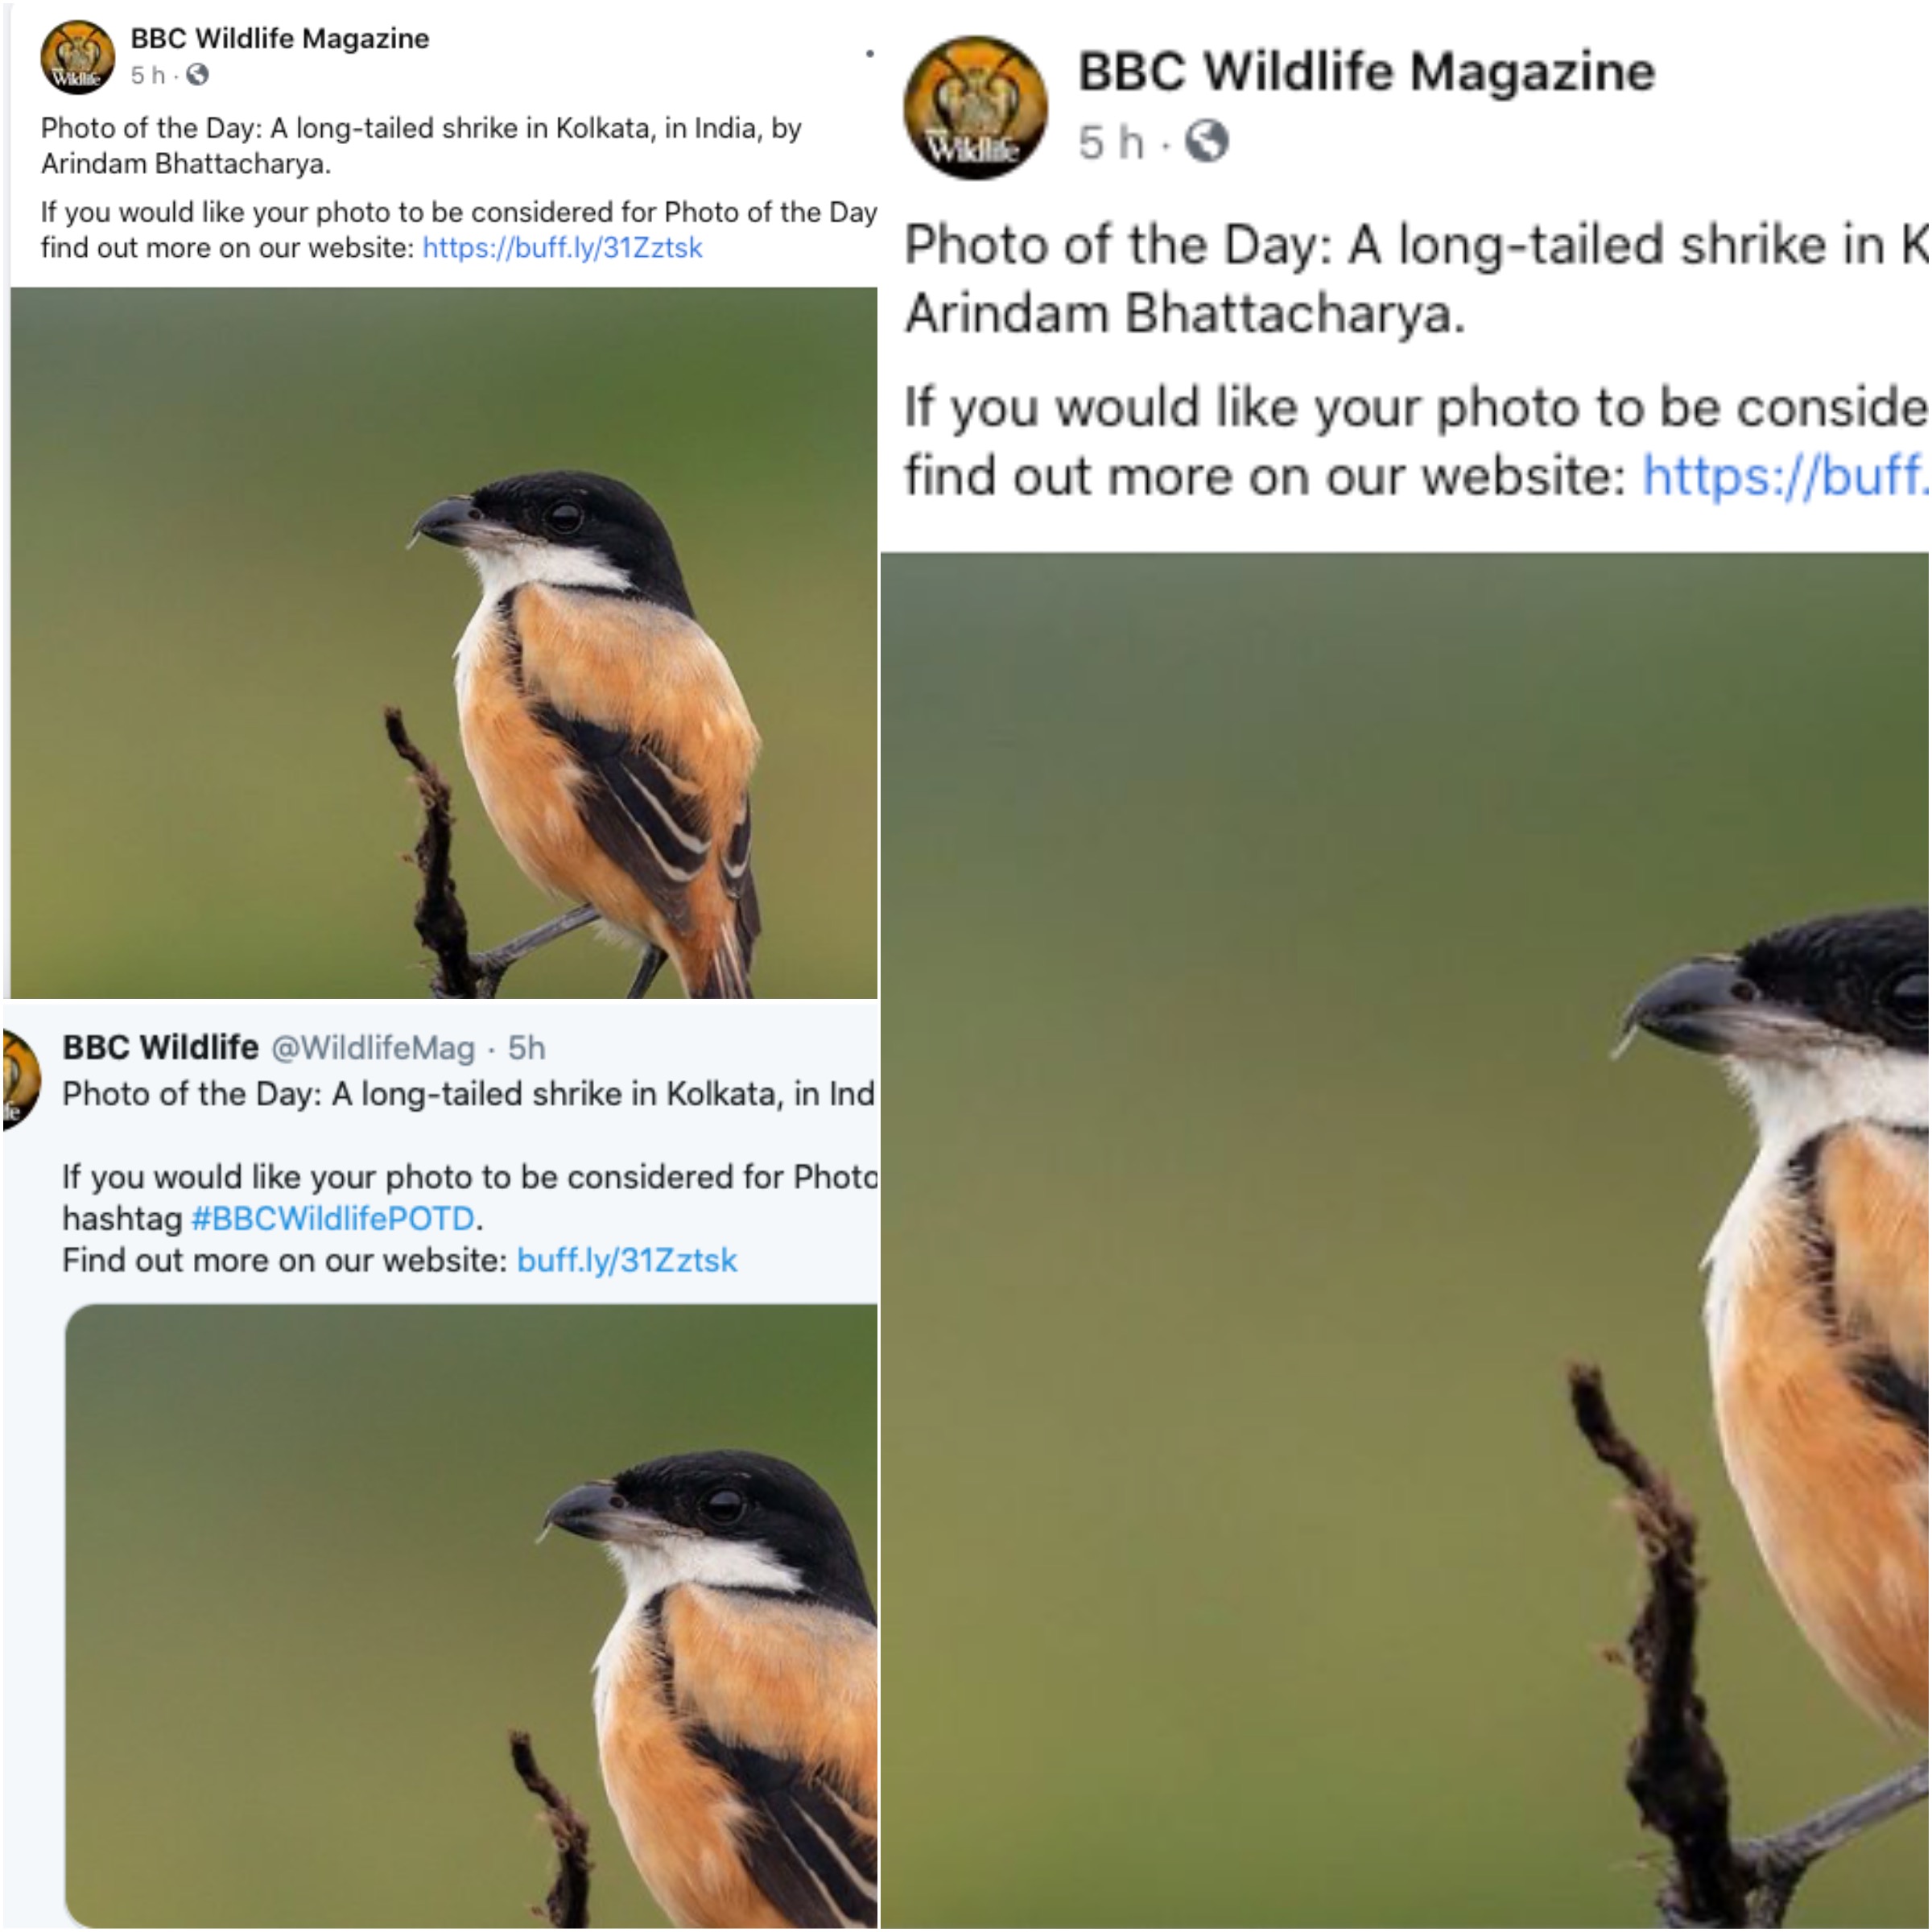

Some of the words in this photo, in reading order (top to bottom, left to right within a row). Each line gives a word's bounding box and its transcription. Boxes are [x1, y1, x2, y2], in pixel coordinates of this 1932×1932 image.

[131, 27, 188, 50] BBC
[195, 26, 295, 50] Wildlife
[303, 25, 431, 55] Magazine
[131, 65, 145, 85] 5
[152, 65, 165, 85] h
[1080, 48, 1187, 93] BBC
[1202, 47, 1396, 92] Wildlife
[1411, 47, 1657, 102] Magazine
[41, 115, 117, 139] Photo
[123, 114, 150, 139] of
[155, 115, 199, 139] the
[206, 116, 262, 145] Day:
[270, 116, 289, 139] A
[297, 115, 434, 145] long-tailed
[442, 115, 518, 139] shrike
[526, 114, 548, 139] in
[557, 115, 657, 144] Kolkata,
[665, 115, 687, 139] in
[696, 115, 763, 144] India,
[772, 115, 803, 145] by
[1080, 124, 1104, 160] 5
[1120, 124, 1144, 160] h
[40, 151, 147, 175] Arindam
[155, 151, 331, 180] Bhattacharya.
[41, 199, 58, 223] If
[64, 205, 111, 229] you
[118, 199, 194, 223] would
[202, 199, 246, 223] like
[252, 205, 310, 229] your
[316, 199, 391, 229] photo
[398, 200, 425, 223] to
[431, 199, 464, 223] be
[471, 199, 613, 223] considered
[621, 199, 658, 223] for
[665, 199, 740, 223] Photo
[747, 199, 774, 223] of
[779, 199, 822, 223] the
[830, 200, 877, 229] Day
[39, 234, 89, 258] find
[97, 237, 139, 259] out
[147, 242, 212, 259] more
[219, 242, 251, 258] on
[258, 242, 302, 258] our
[308, 234, 414, 259] website:
[423, 234, 704, 264] https://buff.ly/31Zztsk
[906, 220, 1050, 266] Photo
[1064, 220, 1114, 266] of
[1127, 220, 1208, 266] the
[1225, 221, 1331, 276] Day:
[1347, 222, 1383, 265] A
[1400, 219, 1664, 276] long-tailed
[1680, 220, 1827, 266] shrike
[1843, 219, 1885, 265] in
[903, 288, 1109, 334] Arindam
[1126, 288, 1465, 345] Bhattacharya.
[906, 382, 937, 427] If
[949, 395, 1038, 439] you
[1054, 382, 1199, 428] would
[1217, 382, 1299, 428] like
[1314, 395, 1424, 439] your
[1438, 382, 1581, 438] photo
[1595, 386, 1645, 427] to
[1661, 382, 1722, 428] be
[1736, 382, 1929, 428] conside
[902, 451, 996, 497] find
[1013, 455, 1093, 497] out
[1108, 464, 1234, 497] more
[1249, 464, 1310, 497] on
[1326, 464, 1408, 497] our
[1420, 451, 1624, 497] website:
[63, 1034, 130, 1061] BBC
[138, 1031, 260, 1061] Wildlife
[271, 1034, 475, 1067] @WildlifeMag
[509, 1034, 546, 1061] 5h
[63, 1078, 151, 1107] Photo
[159, 1078, 190, 1107] of
[197, 1079, 246, 1107] the
[257, 1080, 321, 1113] Day:
[331, 1080, 353, 1107] A
[362, 1078, 522, 1113] long-tailed
[533, 1078, 623, 1107] shrike
[632, 1078, 658, 1107] in
[667, 1079, 784, 1113] Kolkata,
[795, 1078, 820, 1107] in
[831, 1078, 875, 1107] Ind
[63, 1162, 82, 1190] If
[90, 1170, 145, 1196] you
[153, 1162, 242, 1190] would
[253, 1162, 301, 1190] like
[310, 1170, 378, 1196] your
[386, 1162, 473, 1196] photo
[481, 1164, 511, 1190] to
[522, 1162, 559, 1190] be
[568, 1162, 734, 1190] considered
[742, 1162, 785, 1190] for
[794, 1162, 877, 1190] Photo
[63, 1203, 183, 1238] hashtag
[190, 1203, 483, 1232] #BBCWildlifePOTD.
[63, 1245, 126, 1273] Find
[134, 1248, 184, 1273] out
[193, 1253, 270, 1273] more
[279, 1253, 316, 1273] on
[325, 1253, 375, 1274] our
[382, 1245, 507, 1273] website:
[518, 1245, 739, 1279] buff.ly/31Zztsk
